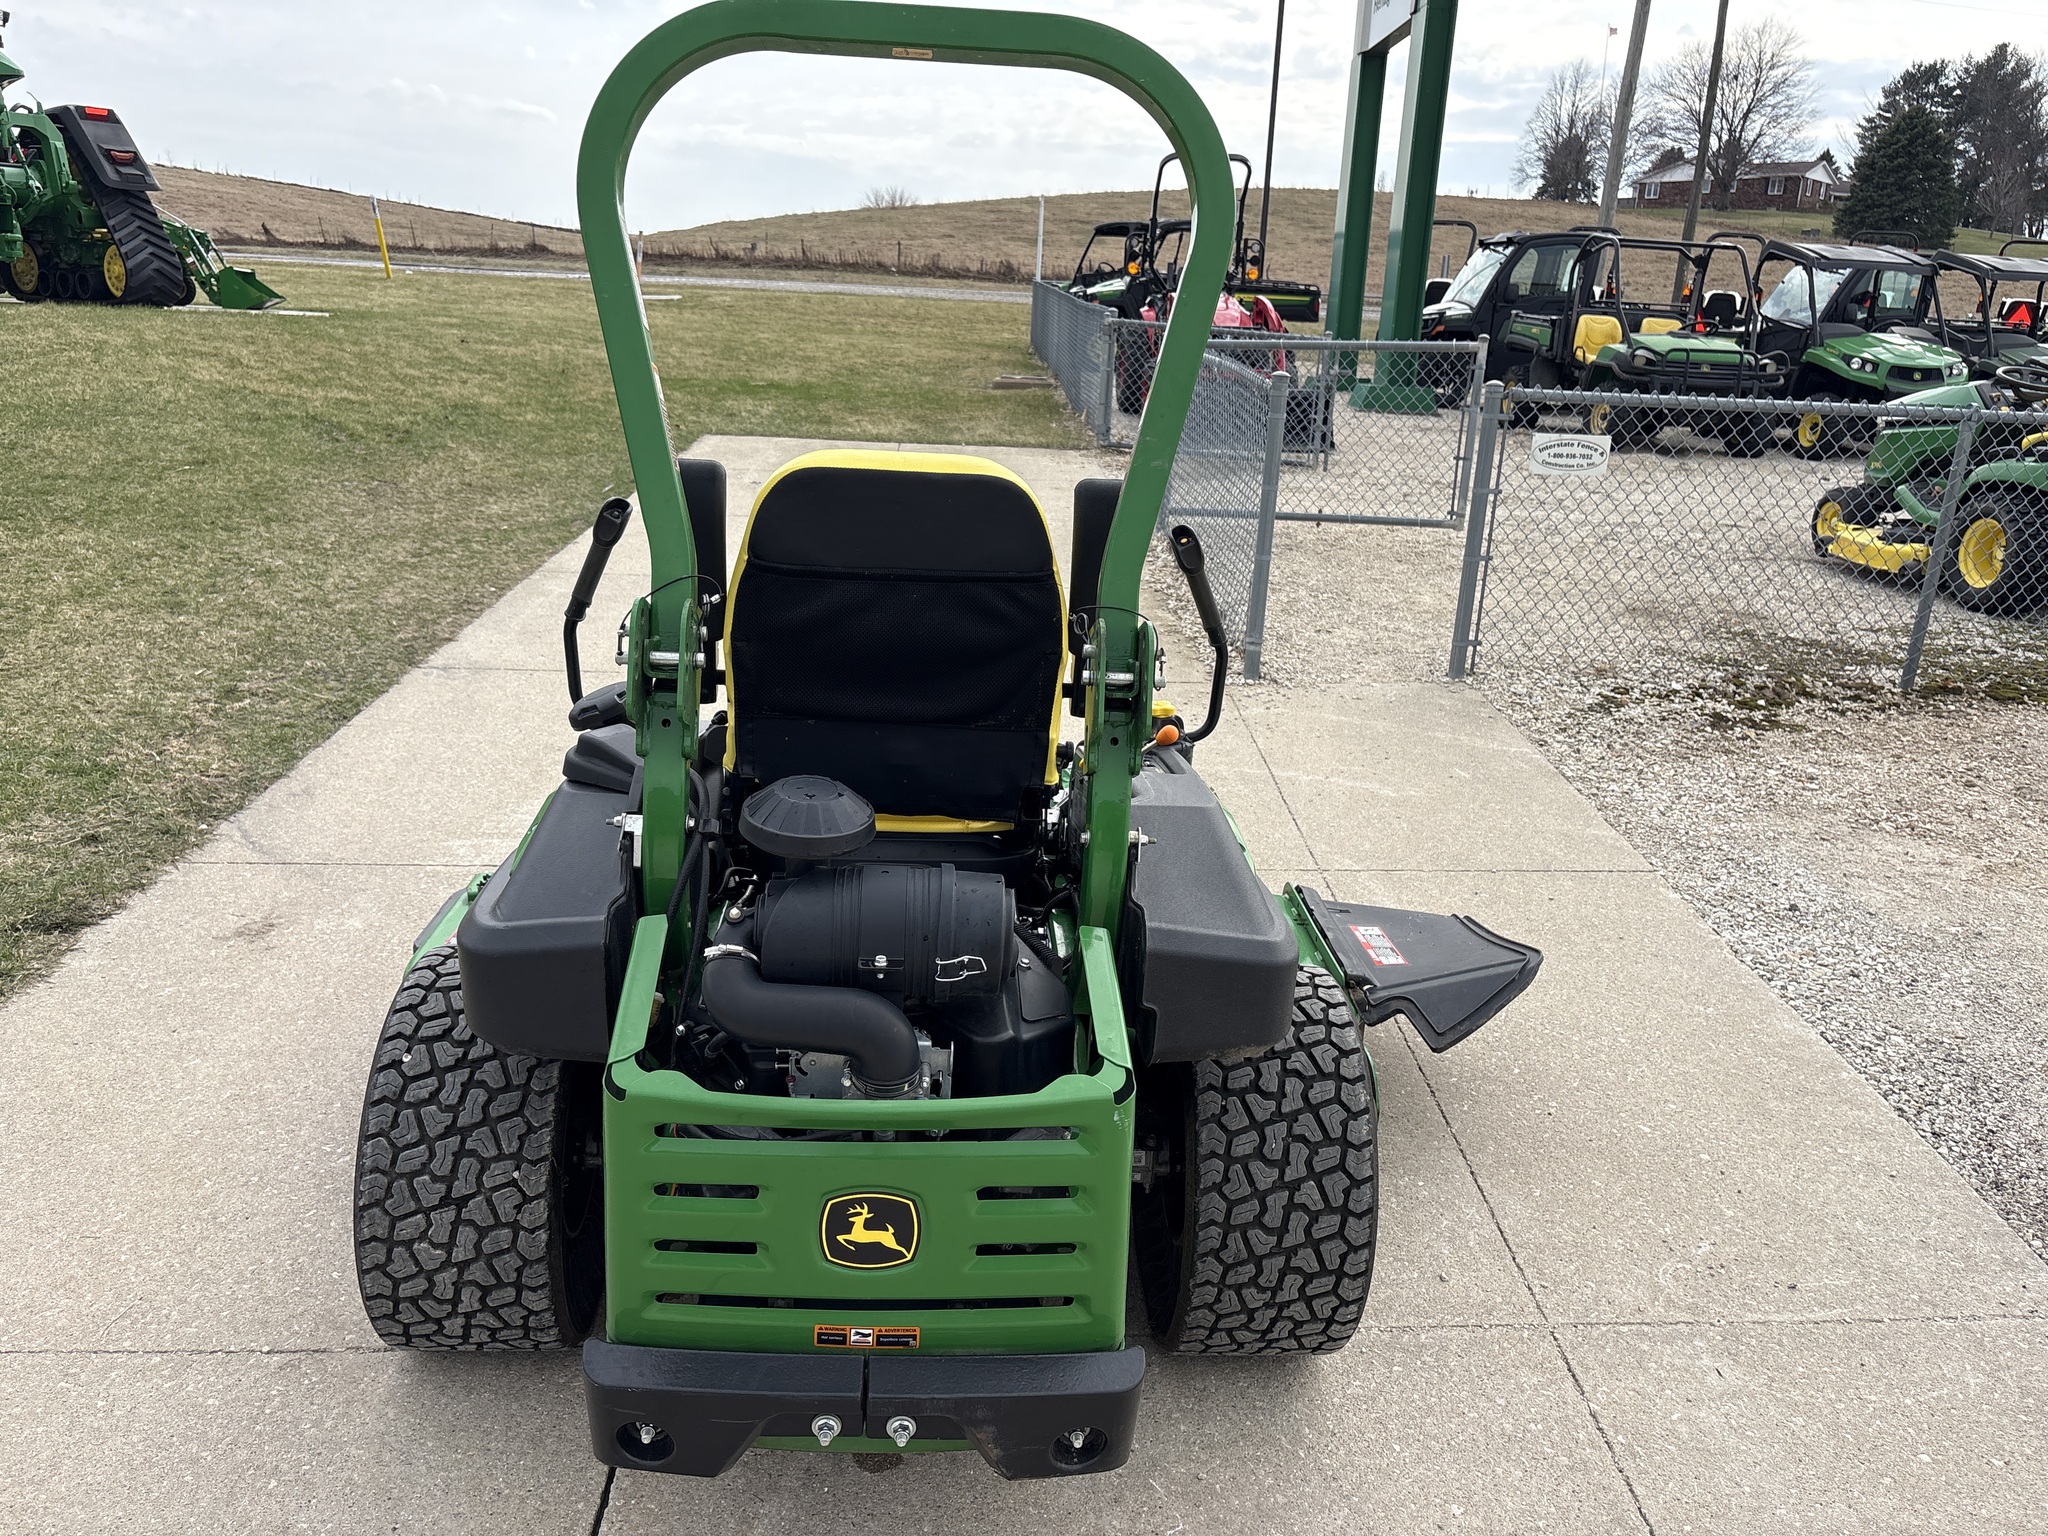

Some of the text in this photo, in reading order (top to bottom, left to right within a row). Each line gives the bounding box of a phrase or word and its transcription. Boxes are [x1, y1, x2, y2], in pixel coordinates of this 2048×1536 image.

[1538, 441, 1575, 453] Interstate
[1577, 442, 1598, 453] Fence
[1547, 452, 1593, 460] 1-800-936-7032
[1541, 459, 1575, 469] Construction
